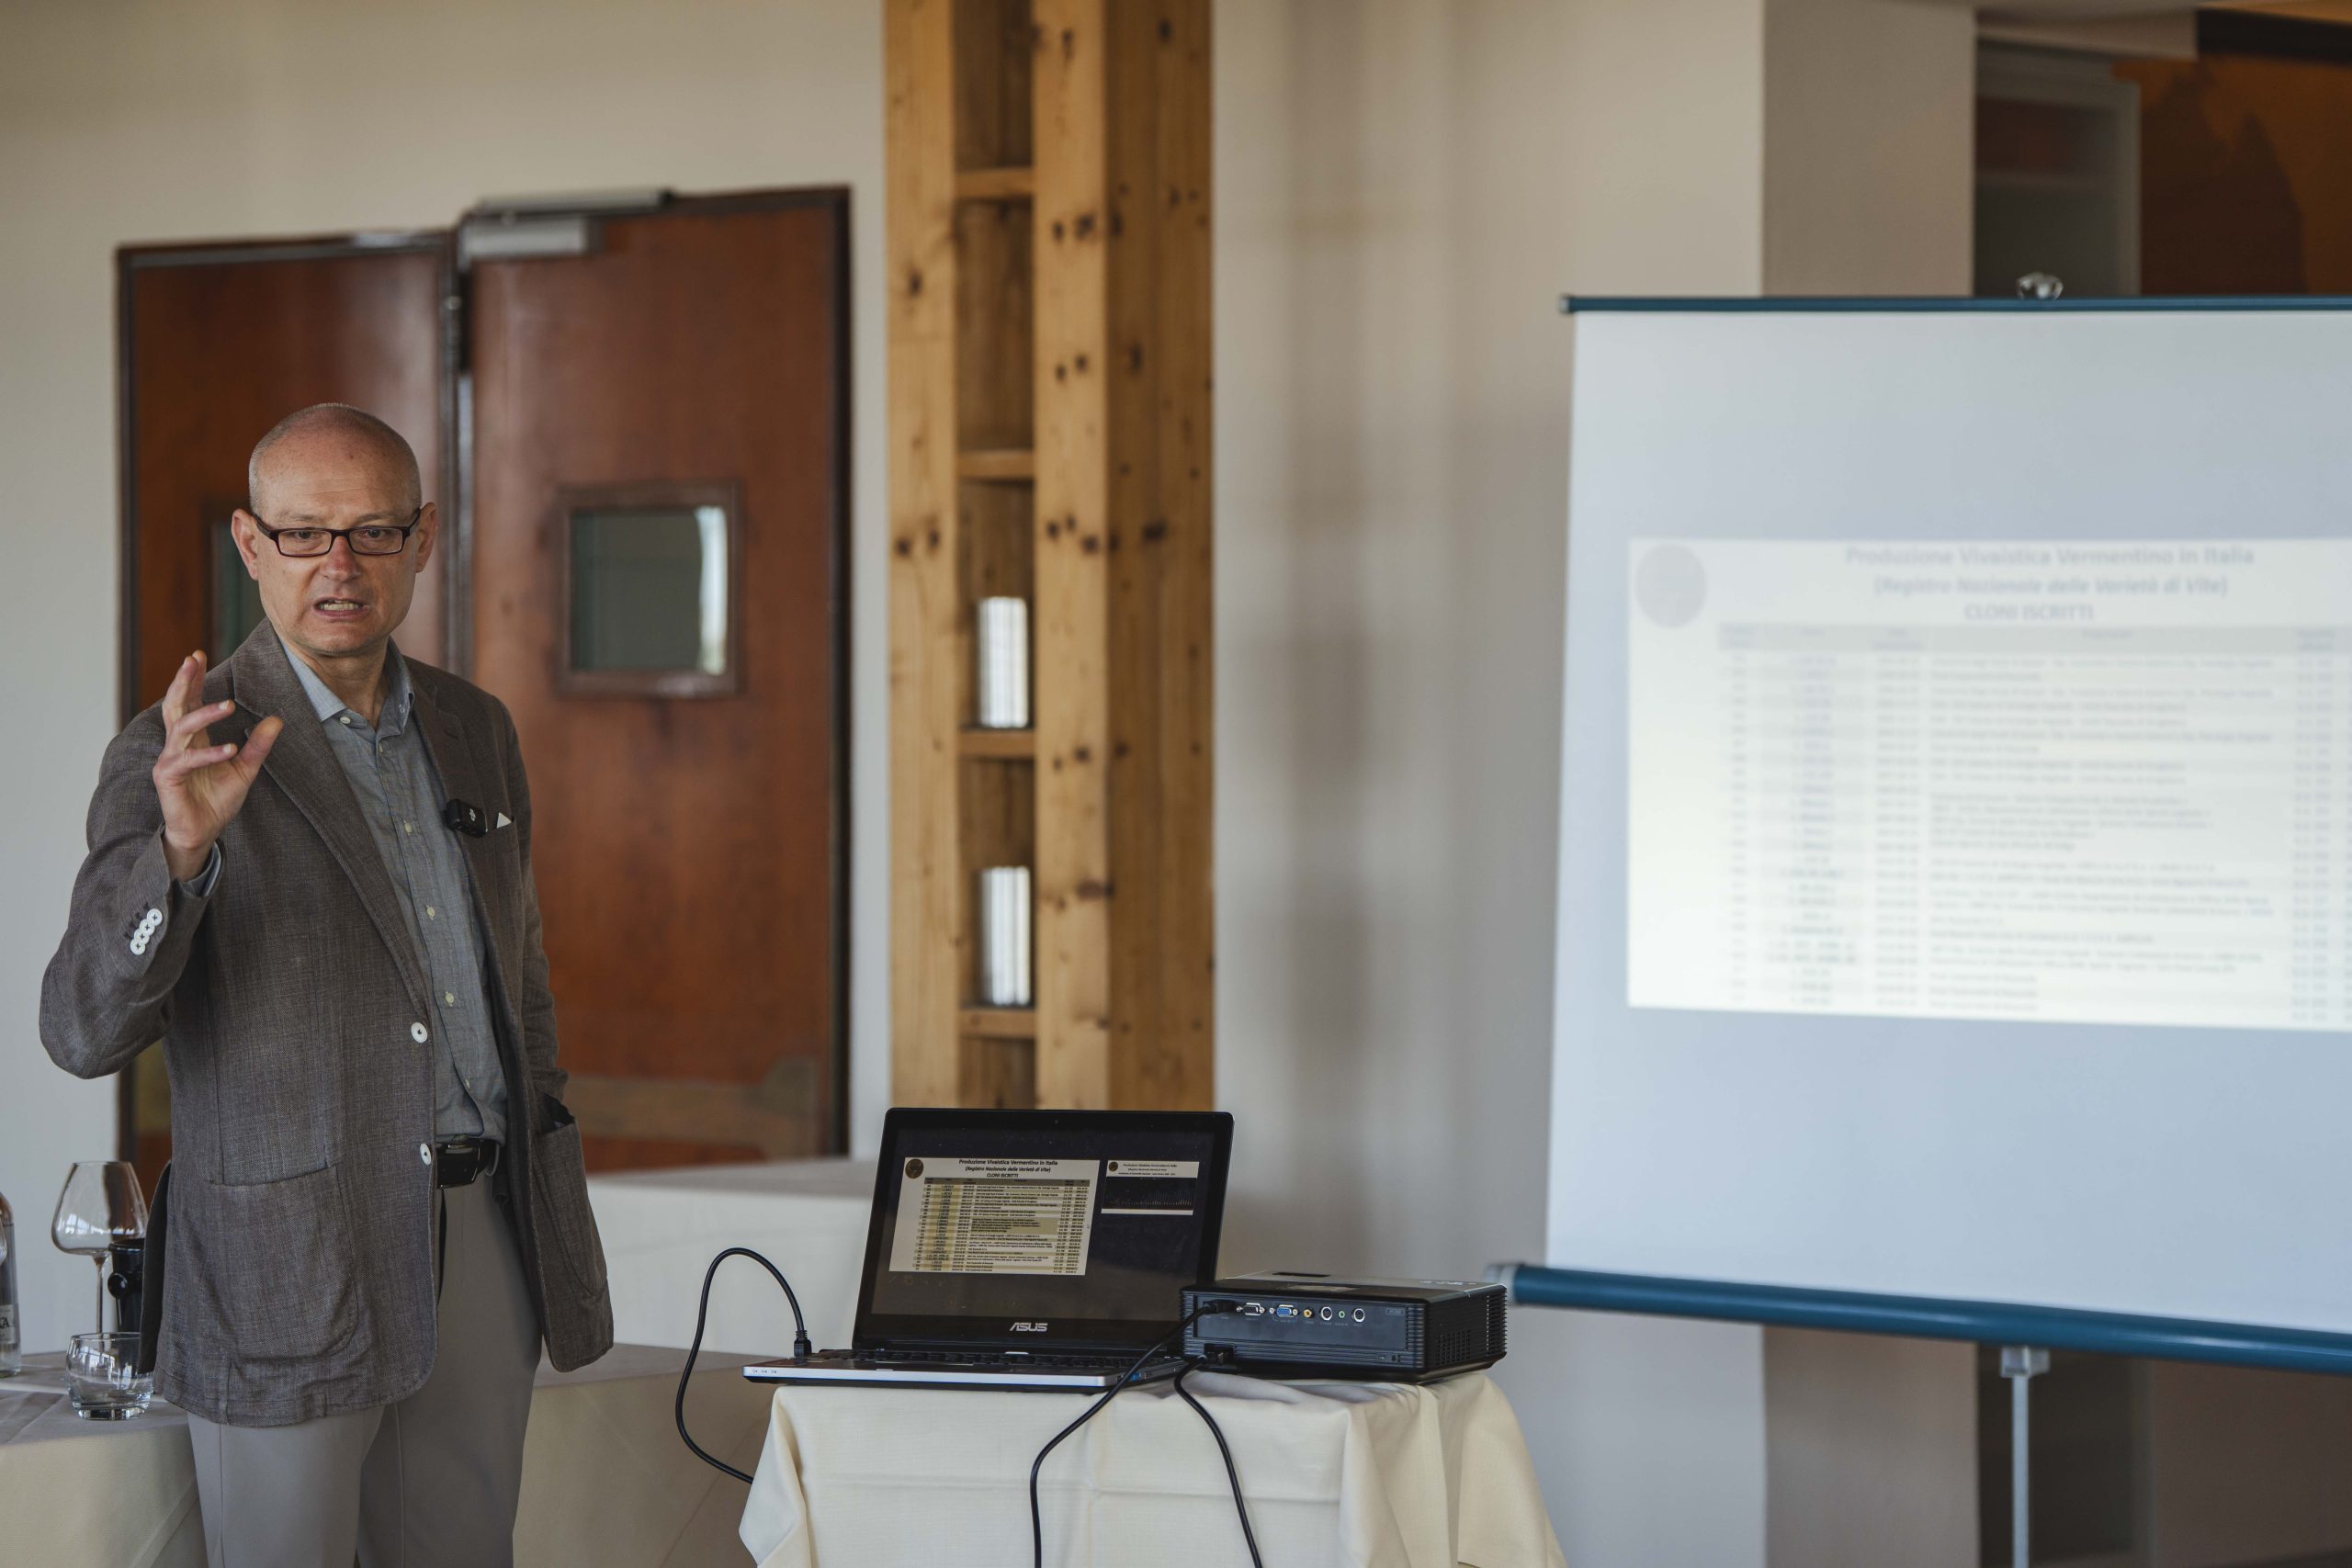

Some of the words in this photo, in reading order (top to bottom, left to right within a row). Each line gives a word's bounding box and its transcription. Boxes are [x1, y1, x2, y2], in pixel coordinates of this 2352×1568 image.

[1844, 546, 1952, 567] Produzione
[1958, 546, 2051, 567] Vivaistica
[2057, 546, 2176, 567] Vermentino
[2180, 546, 2199, 566] in
[2204, 545, 2256, 566] Italia
[1956, 576, 2042, 595] Nazionale
[2047, 576, 2090, 595] delle
[2163, 575, 2181, 595] di
[1964, 602, 2018, 622] CLONI
[2023, 602, 2094, 622] ISCRITTI
[1009, 1322, 1048, 1332] ASUS
